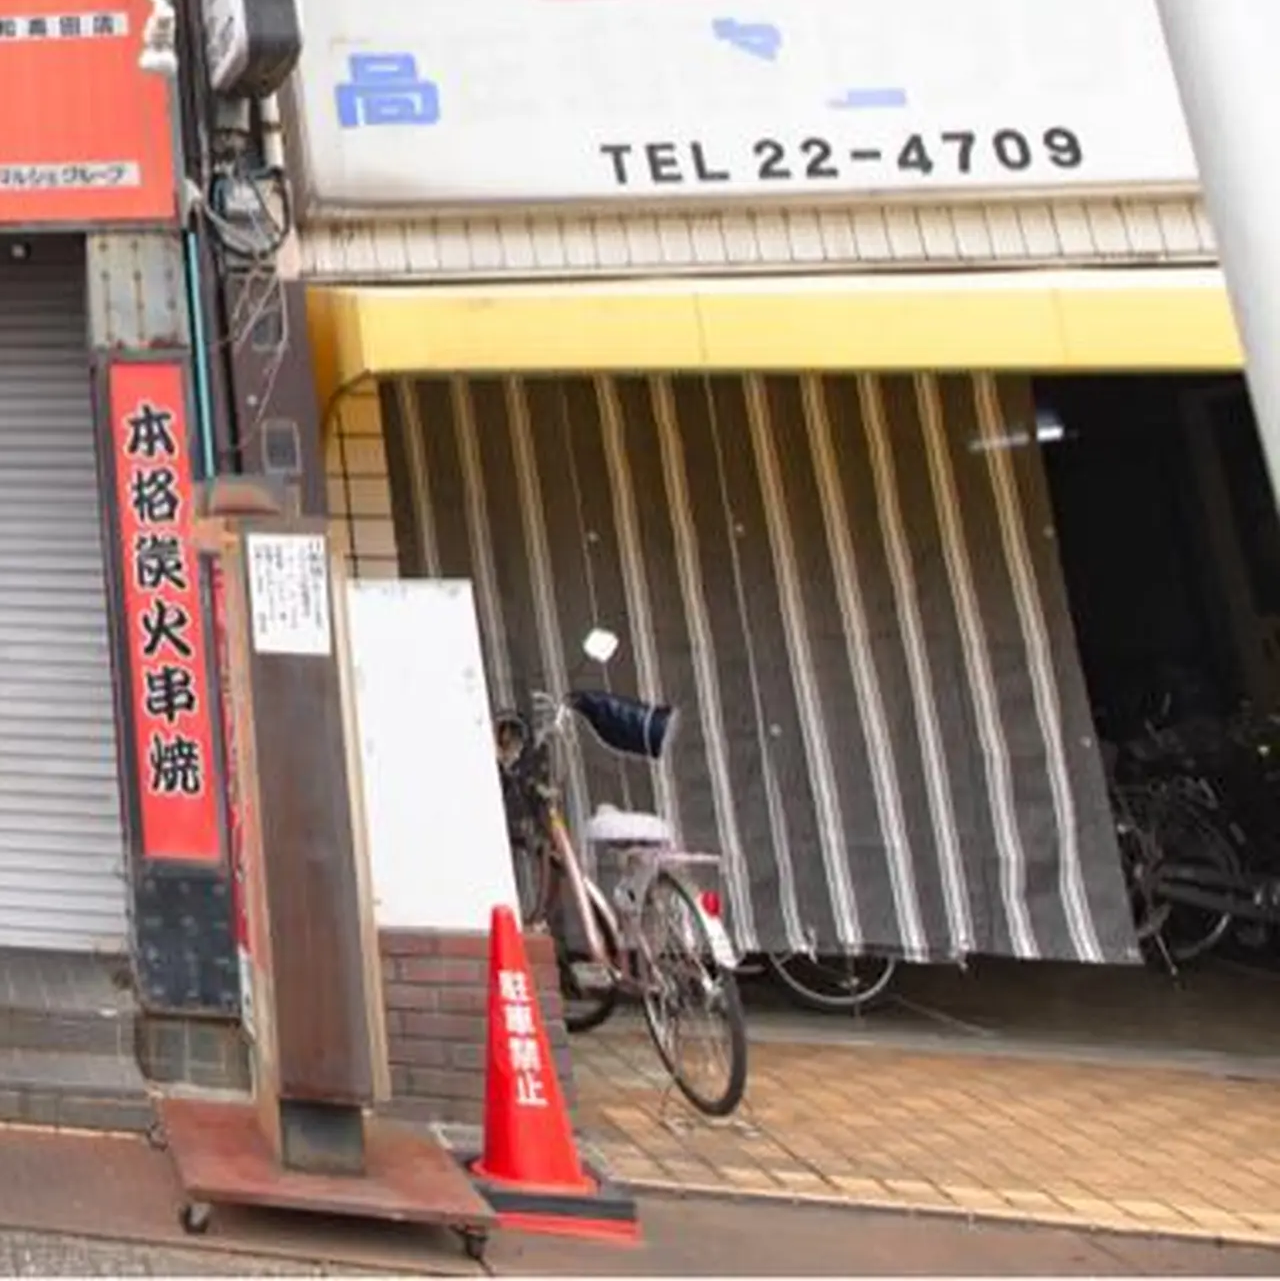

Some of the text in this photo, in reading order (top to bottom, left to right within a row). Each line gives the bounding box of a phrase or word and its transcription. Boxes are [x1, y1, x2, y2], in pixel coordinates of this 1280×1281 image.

[600, 126, 1085, 185] TEL 22-4709
[126, 403, 203, 799] 本格炭火串焼
